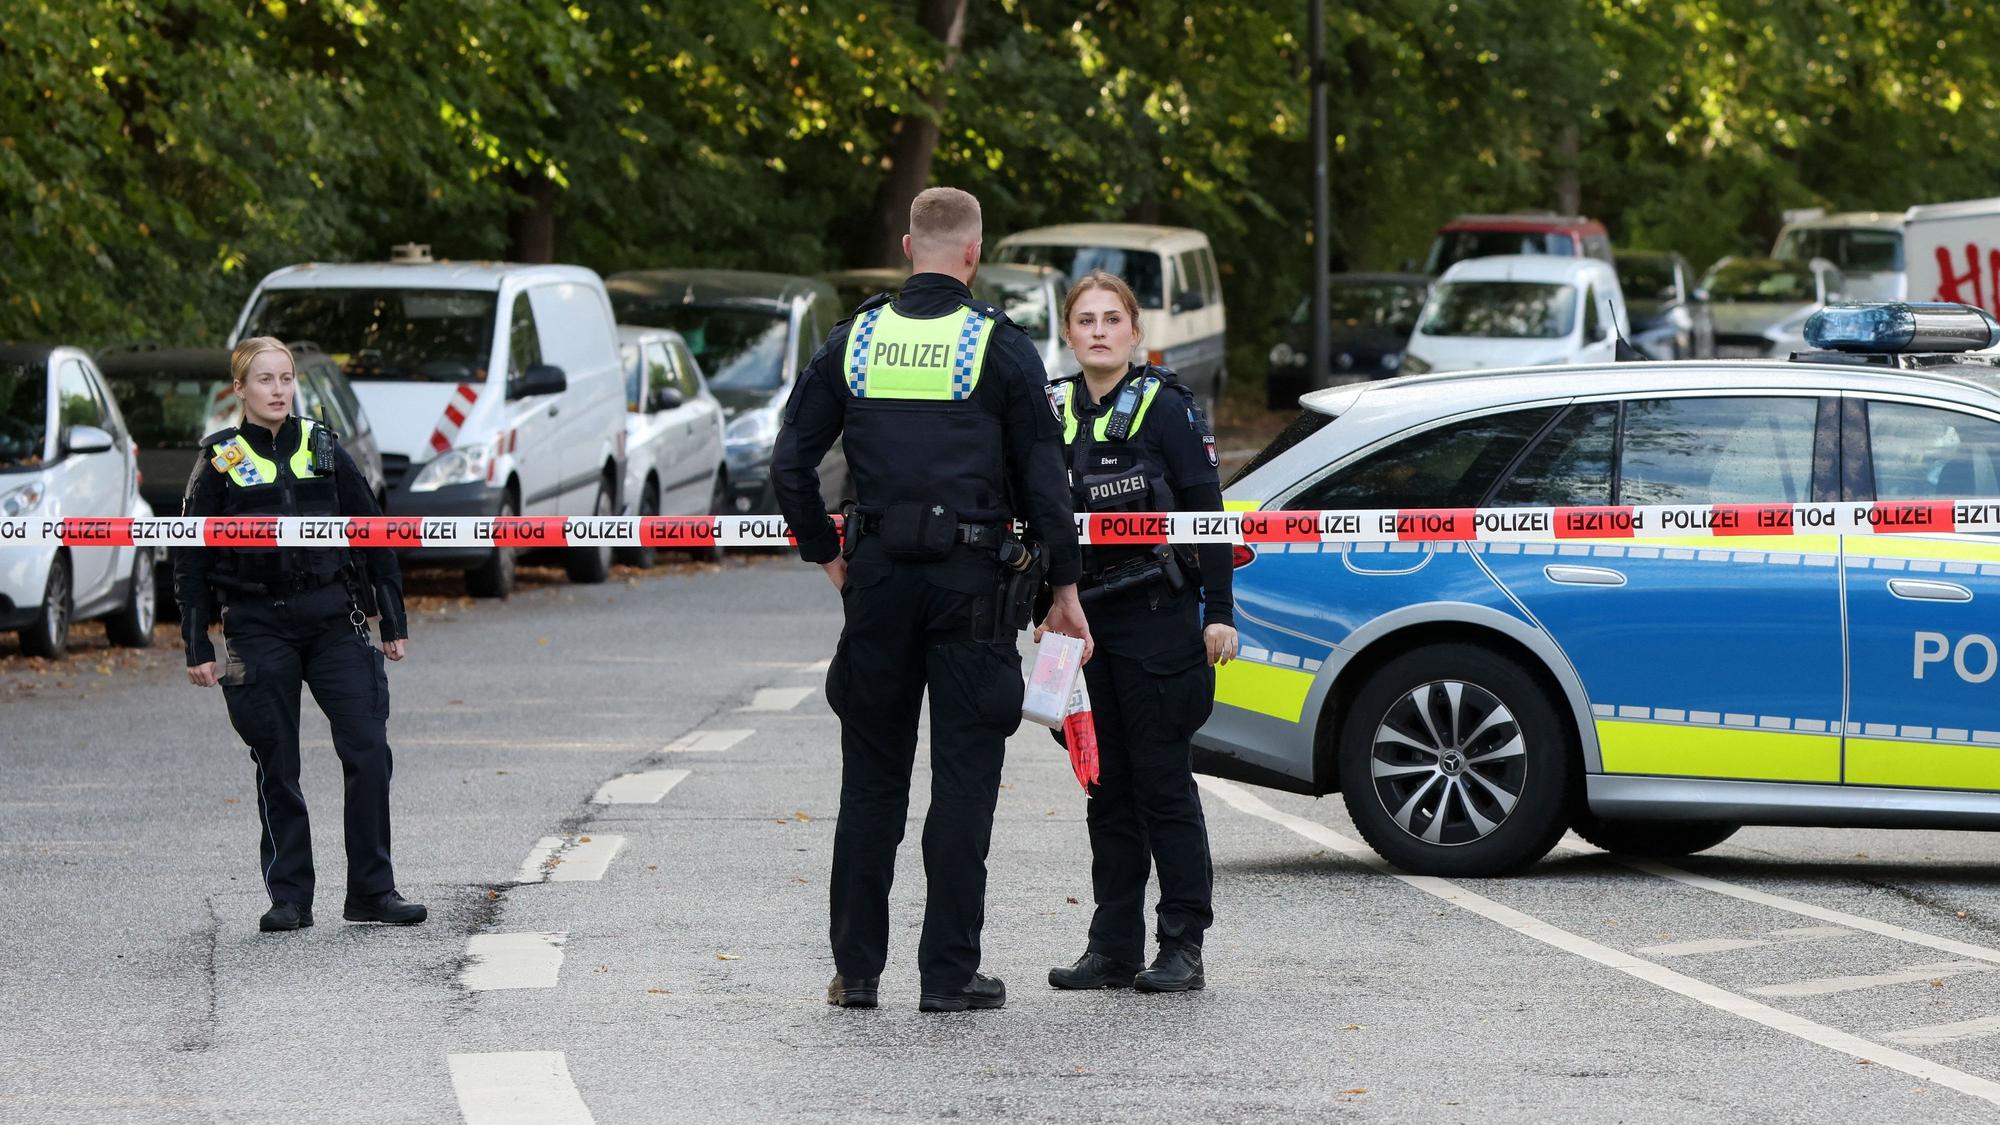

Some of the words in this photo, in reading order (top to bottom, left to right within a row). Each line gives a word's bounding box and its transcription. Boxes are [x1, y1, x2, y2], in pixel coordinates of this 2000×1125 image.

[874, 342, 950, 368] POLIZEI
[1101, 457, 1118, 465] Ebert
[1090, 475, 1145, 500] POLIZEI
[42, 521, 111, 539] POLIZEI
[128, 521, 197, 539] POLIZEI
[213, 521, 283, 539] POLIZEI
[299, 521, 369, 539] POLIZEI
[387, 521, 456, 540] POLIZEI
[474, 521, 544, 539] POLIZEI
[562, 521, 632, 539] POLIZEI
[650, 521, 721, 538] POLIZEI
[1101, 517, 1175, 536] POLIZEI
[1193, 517, 1268, 535] POLIZEI
[1285, 515, 1360, 534] POLIZEI
[1379, 513, 1455, 533] POLIZEI
[1472, 512, 1548, 532] POLIZEI
[1567, 511, 1643, 530] POLIZEI
[1661, 510, 1738, 529] POLIZEI
[1758, 507, 1834, 527] POLIZEI
[1854, 506, 1931, 526] POLIZEI
[1913, 631, 1998, 684] PO
